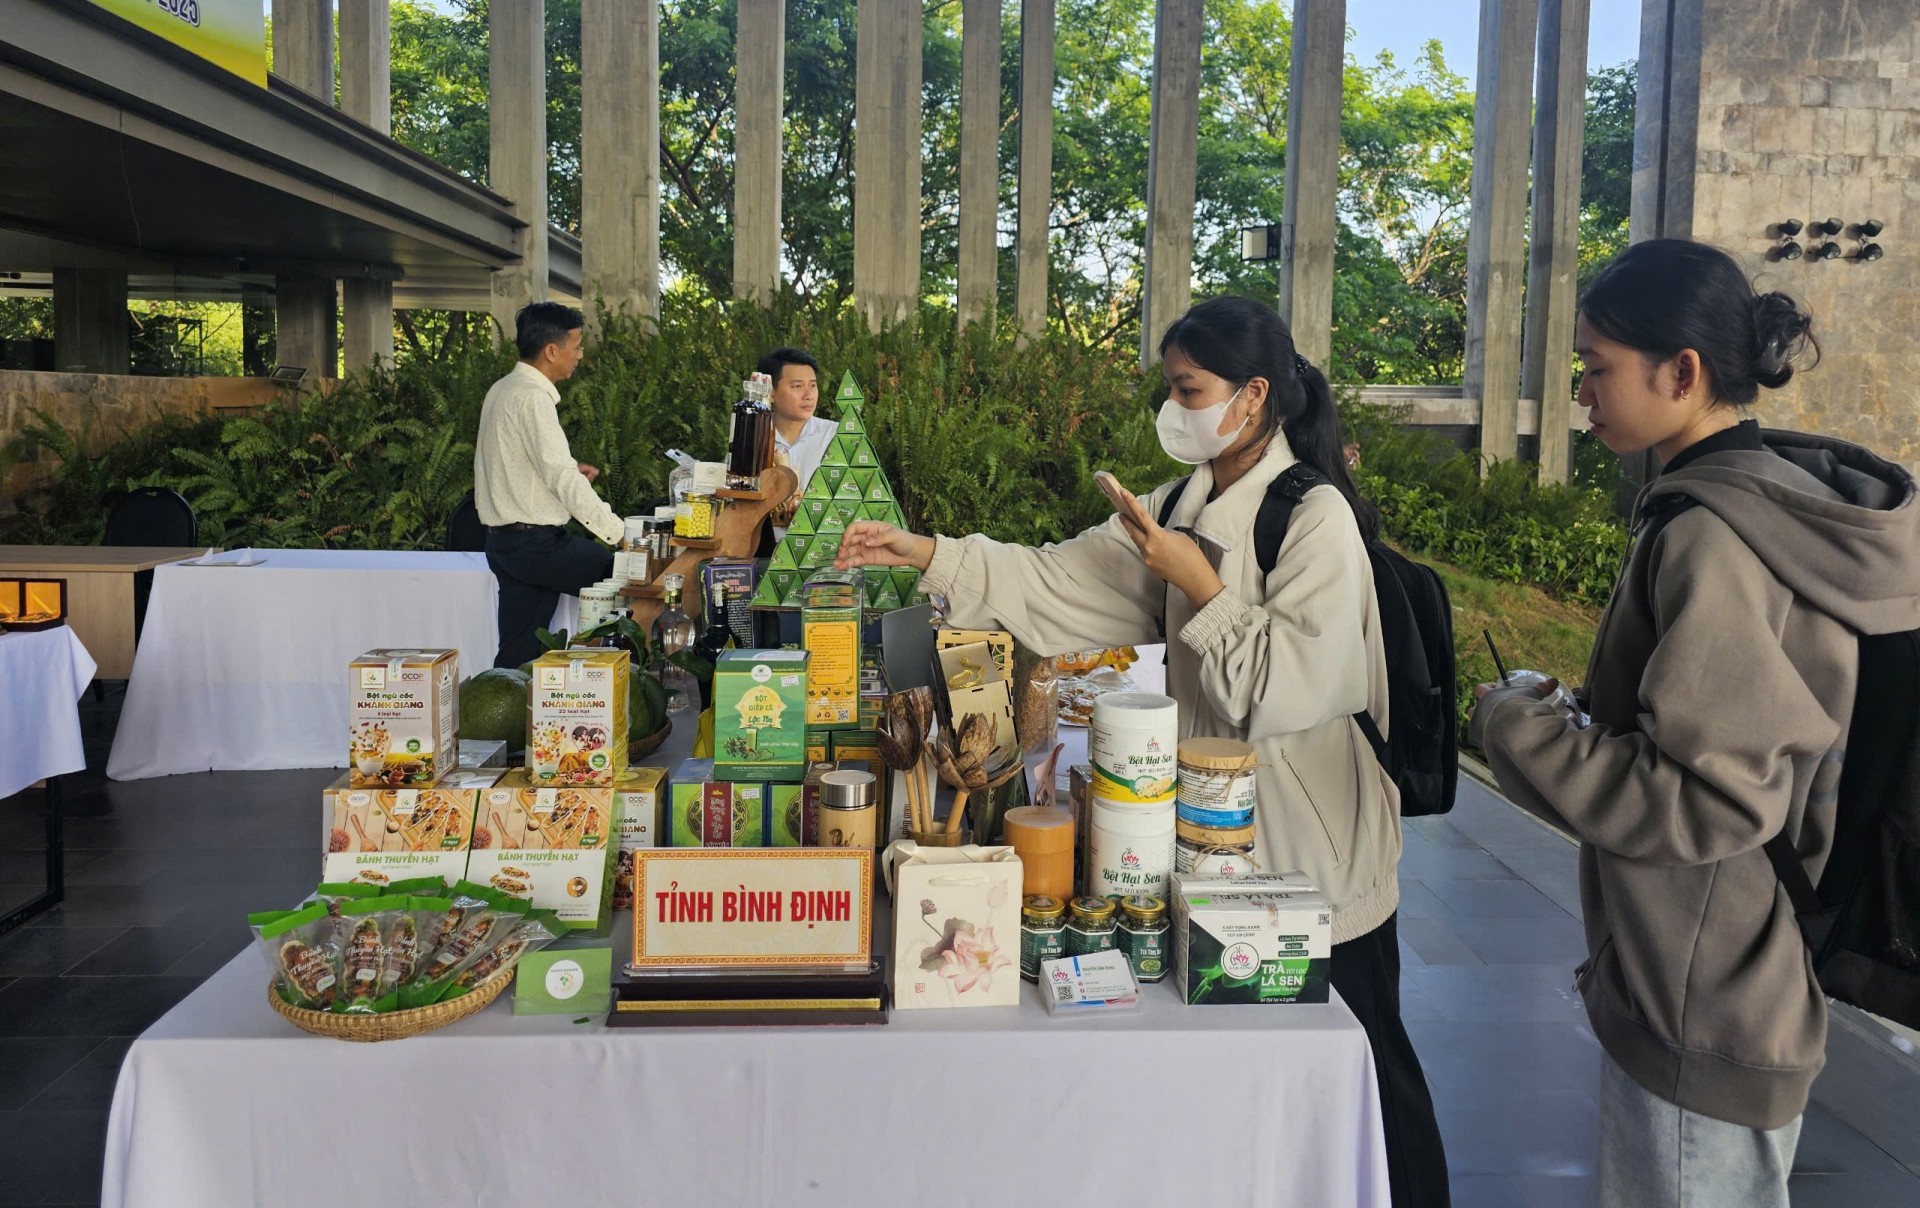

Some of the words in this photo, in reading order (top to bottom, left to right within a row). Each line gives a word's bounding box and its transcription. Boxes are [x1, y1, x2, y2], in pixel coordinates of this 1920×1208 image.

[158, 0, 200, 27] 025
[755, 694, 767, 702] BỘT
[393, 701, 424, 709] GIANG
[1128, 755, 1143, 767] Bột
[1145, 756, 1160, 767] Hạt
[1161, 754, 1172, 763] Sen
[621, 825, 647, 833] IANG
[356, 854, 382, 864] BÁNH
[384, 852, 419, 864] THUYỀN
[421, 856, 440, 866] HẠT
[497, 851, 523, 861] BÁNH
[525, 849, 559, 861] THUYỀN
[561, 853, 580, 863] HẠT
[1103, 869, 1118, 884] Bột
[1121, 872, 1141, 887] Hạt
[1144, 873, 1161, 884] Sen
[655, 881, 713, 924] TỈNH
[722, 884, 783, 923] BÌNH
[790, 890, 851, 929] ĐỊNH
[358, 935, 380, 944] Bánh
[299, 945, 323, 960] Bánh
[375, 946, 393, 956] Hạt
[1261, 960, 1285, 975] TRÀ
[1261, 973, 1276, 986] LÁ
[1279, 975, 1303, 986] SEN
